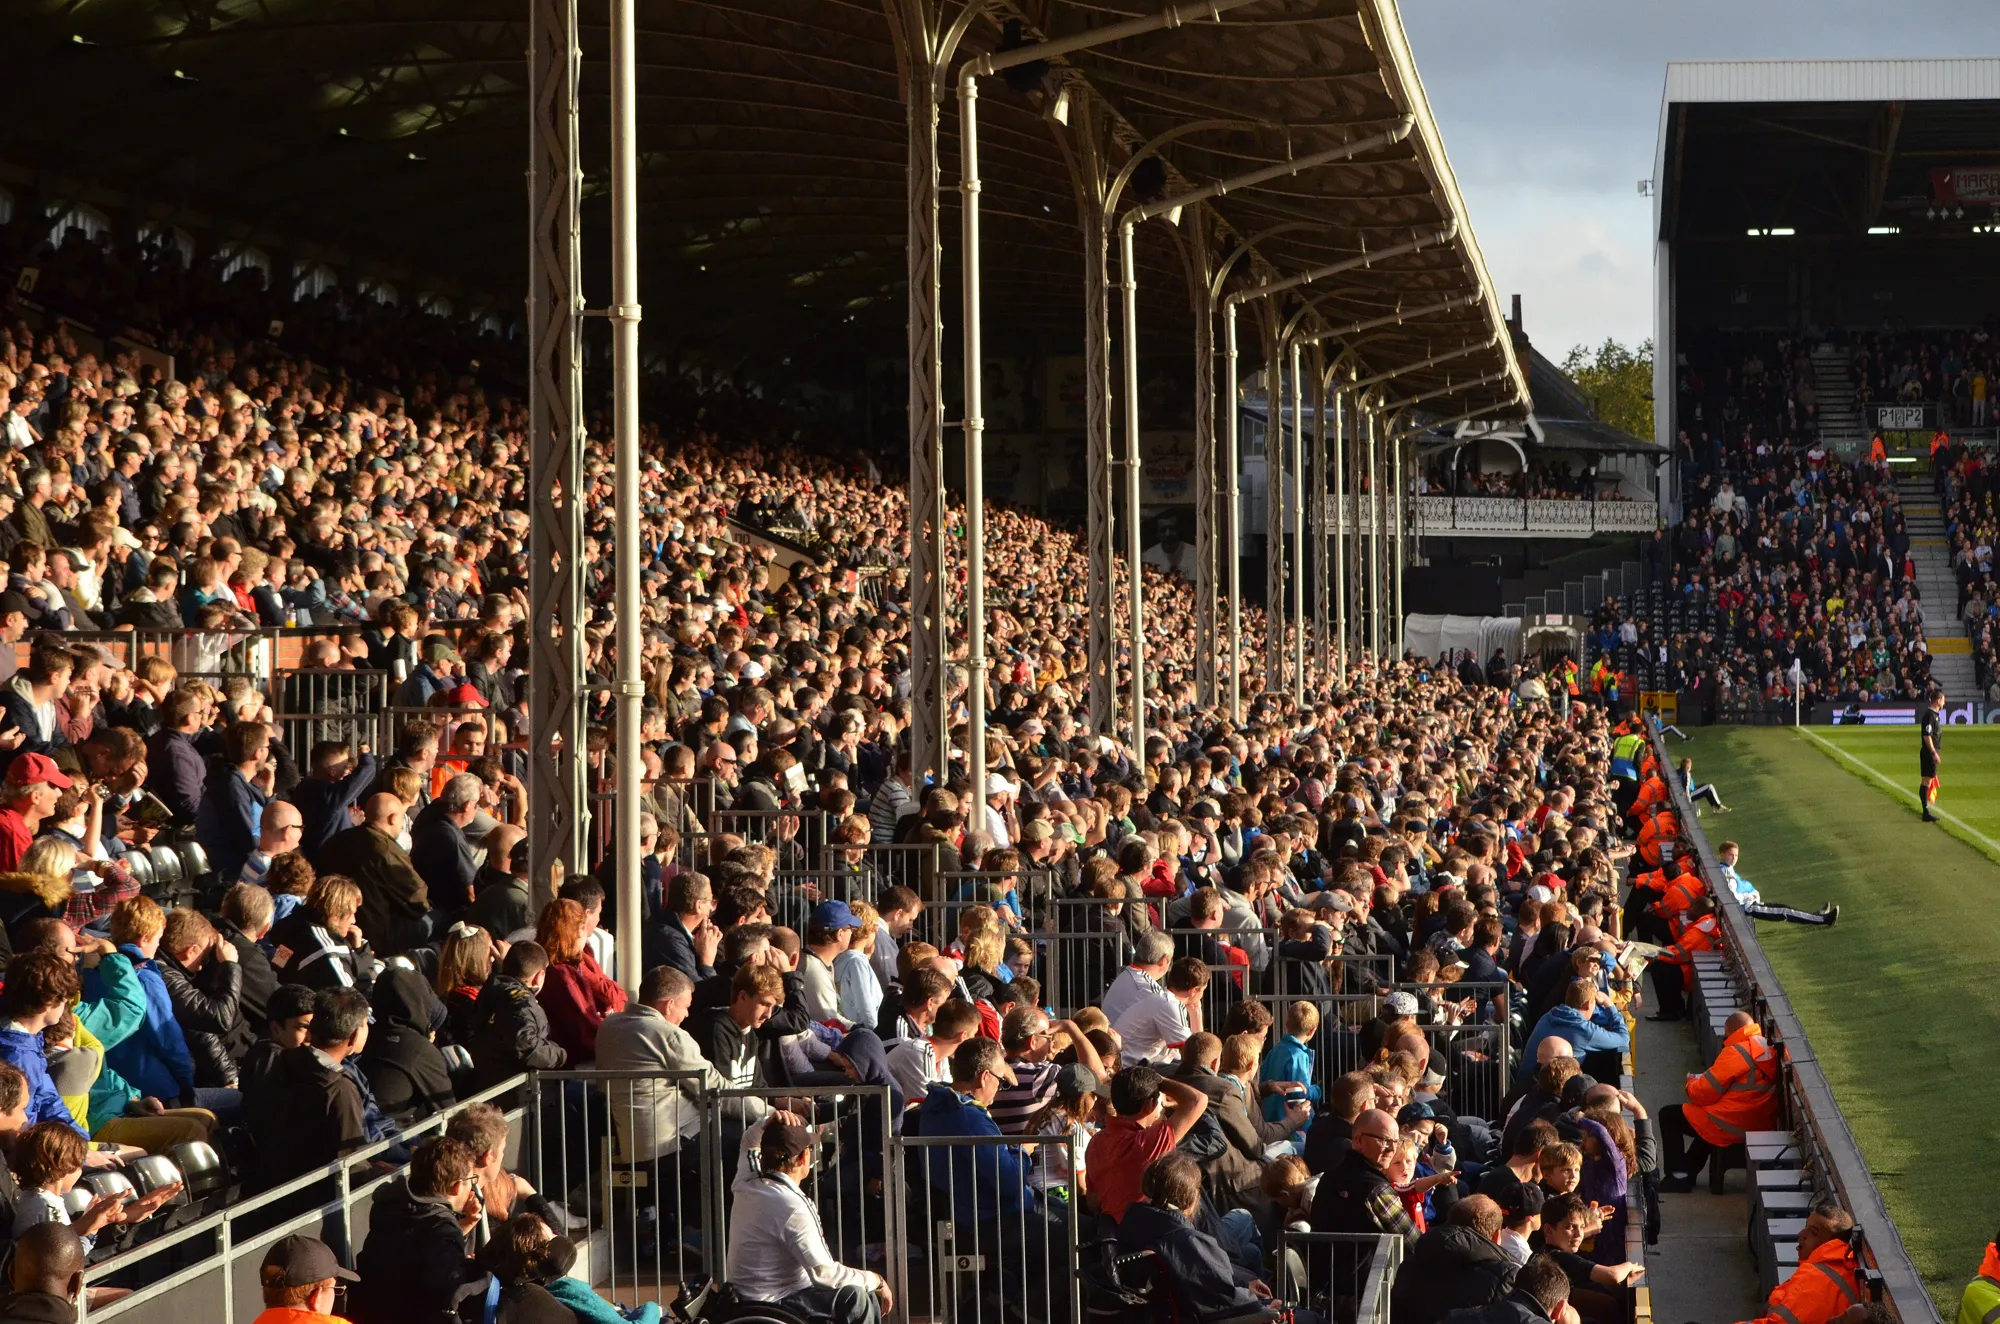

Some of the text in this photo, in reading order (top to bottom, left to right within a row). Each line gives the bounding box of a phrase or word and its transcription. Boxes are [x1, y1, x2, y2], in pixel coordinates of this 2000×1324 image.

[1880, 409, 1894, 422] P1
[1906, 409, 1921, 422] P2
[960, 1258, 967, 1267] 4
